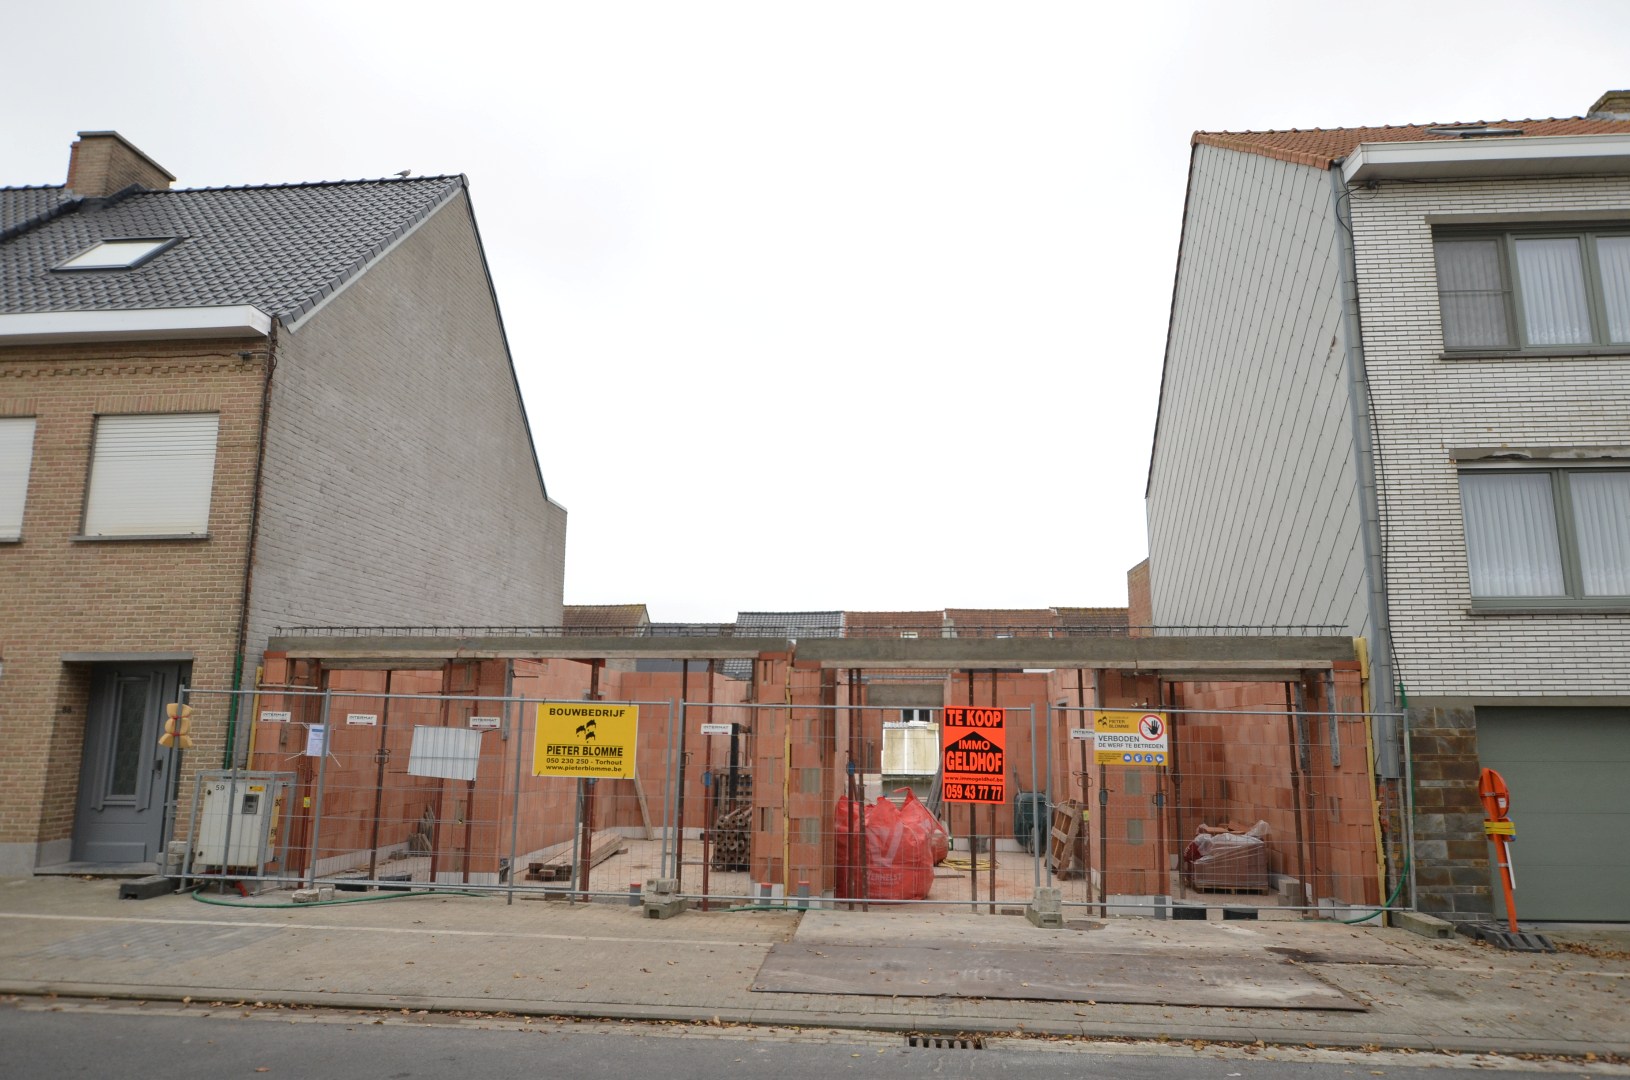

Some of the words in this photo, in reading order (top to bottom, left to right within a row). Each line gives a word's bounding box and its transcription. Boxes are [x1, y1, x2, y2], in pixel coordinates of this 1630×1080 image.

[549, 708, 625, 717] BOUWBEDRIJF
[947, 709, 963, 726] TE
[966, 710, 1002, 727] KOOP
[546, 746, 580, 756] PIETER
[582, 746, 623, 757] BLOMME
[958, 740, 990, 750] IMMO
[946, 750, 1002, 772] GELDHOF
[946, 784, 963, 799] 059
[964, 784, 976, 800] 43
[978, 785, 989, 800] 77
[991, 786, 1002, 800] 77
